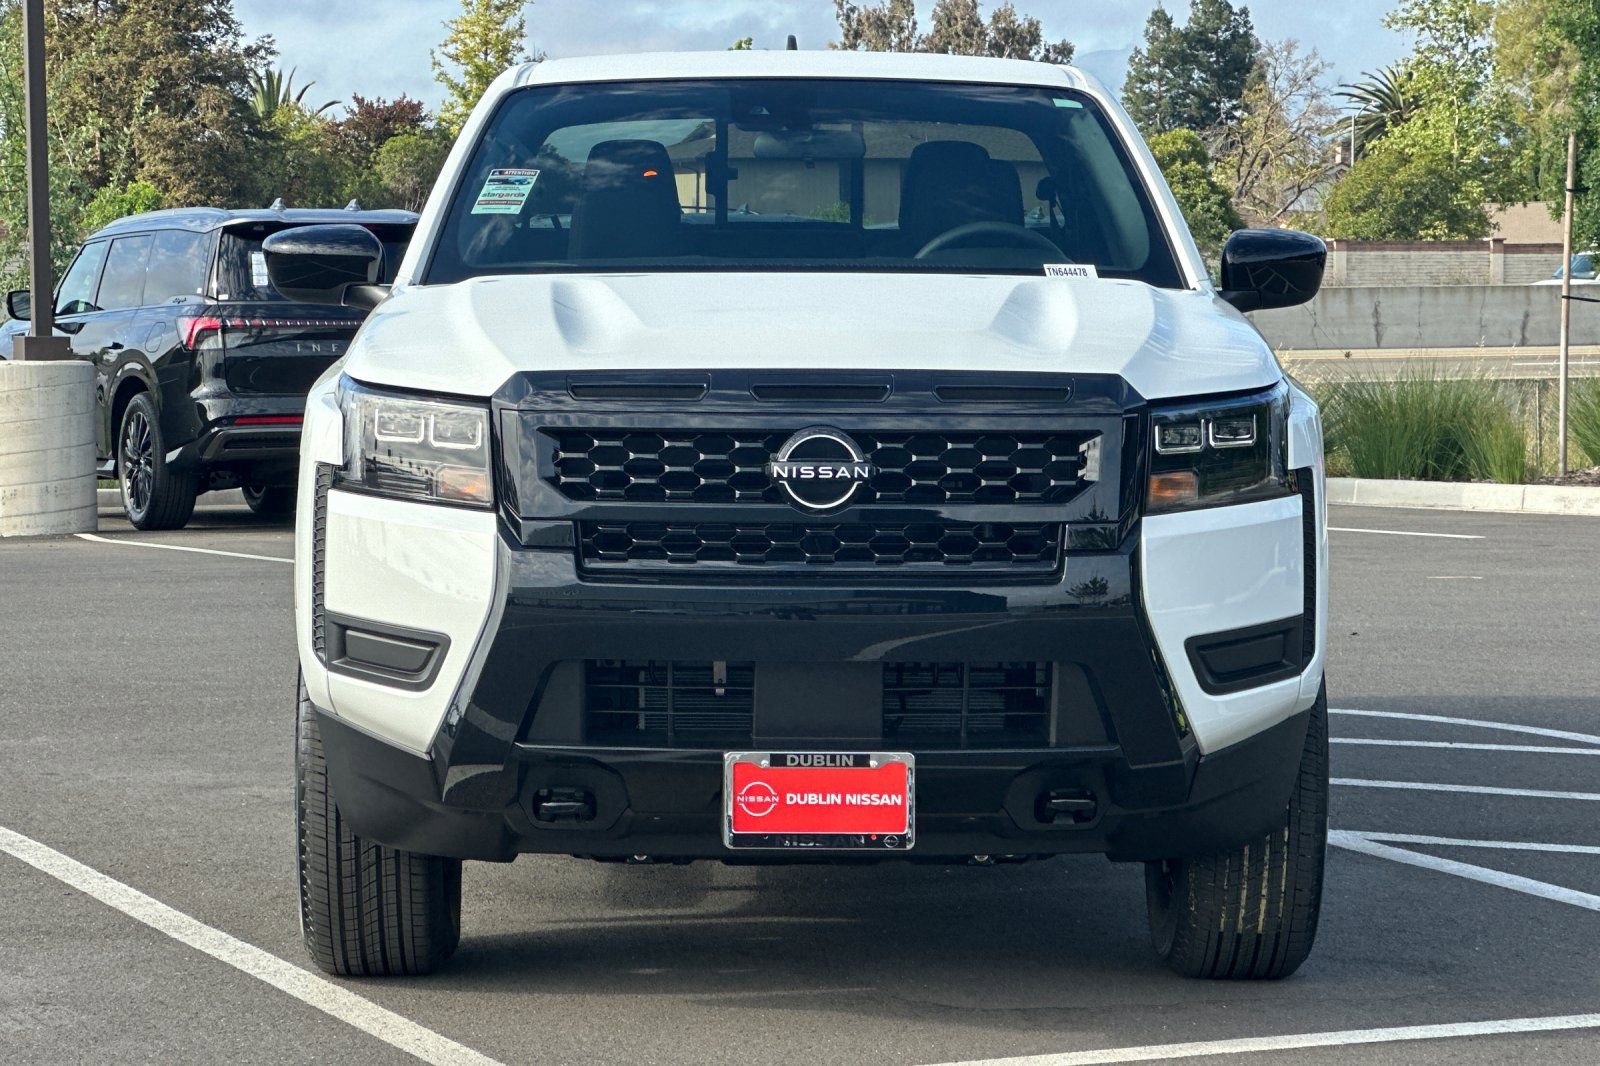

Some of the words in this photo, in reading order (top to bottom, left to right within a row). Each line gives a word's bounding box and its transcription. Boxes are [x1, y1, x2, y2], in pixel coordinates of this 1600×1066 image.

[1046, 267, 1088, 277] TN644478
[773, 466, 869, 478] NISSAN
[786, 754, 854, 767] DUBLIN
[786, 793, 842, 805] DUBLIN
[845, 794, 902, 806] NISSAN
